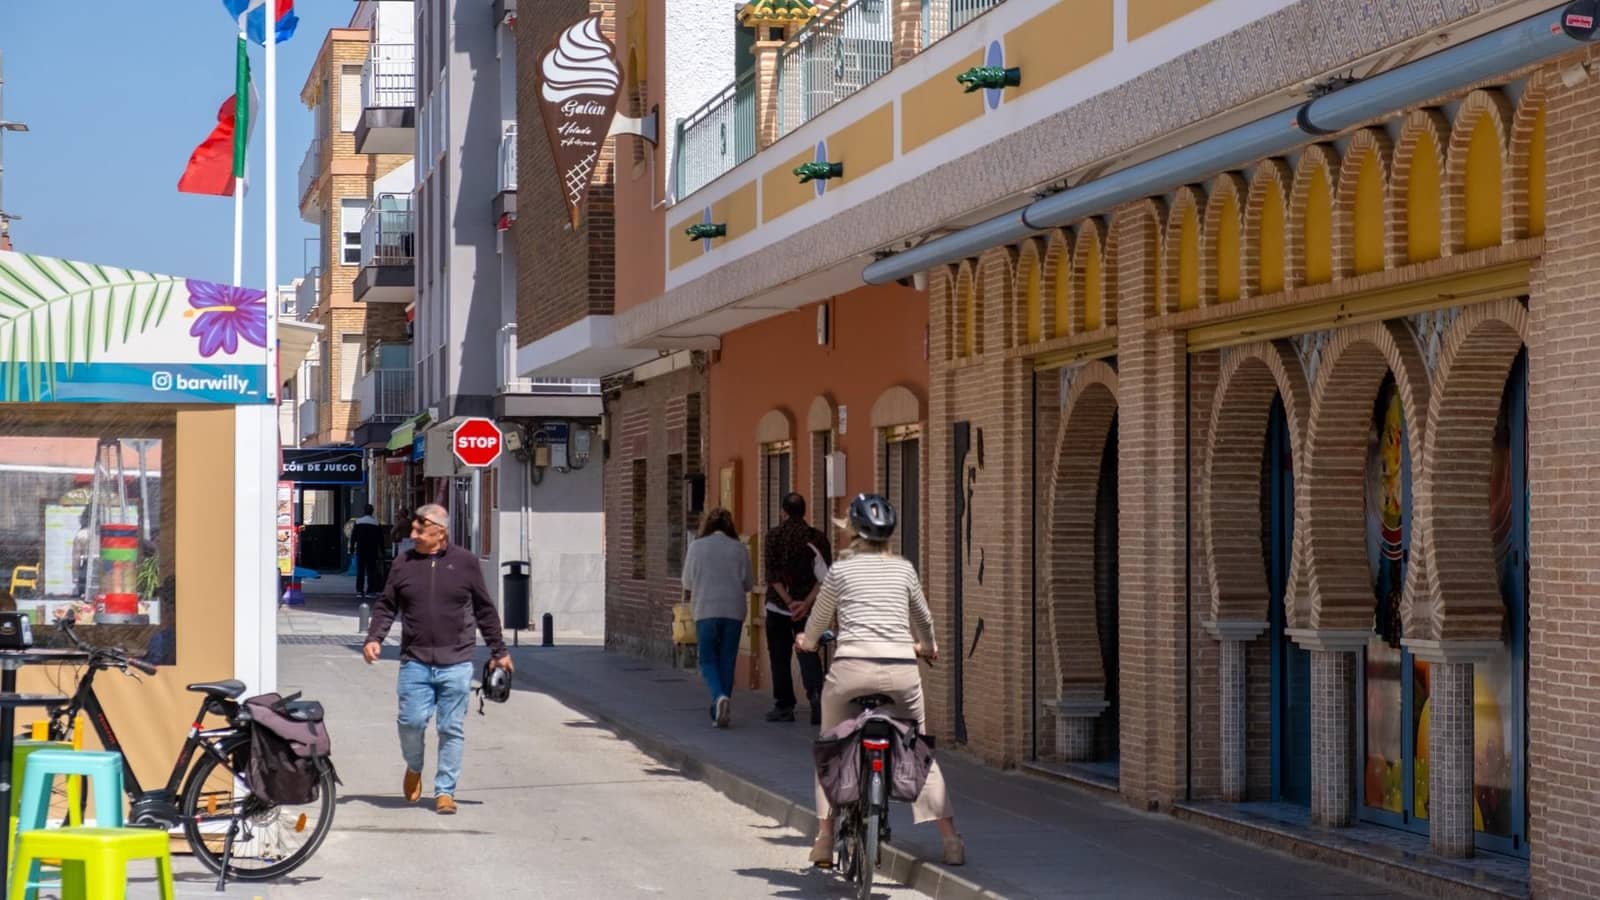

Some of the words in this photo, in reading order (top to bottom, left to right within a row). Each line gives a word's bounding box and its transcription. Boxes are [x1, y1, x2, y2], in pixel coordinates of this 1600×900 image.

[177, 373, 259, 395] barwilly_
[458, 436, 497, 449] STOP
[283, 461, 304, 472] LÓN
[307, 463, 321, 472] DE
[323, 463, 357, 472] JUEGO
